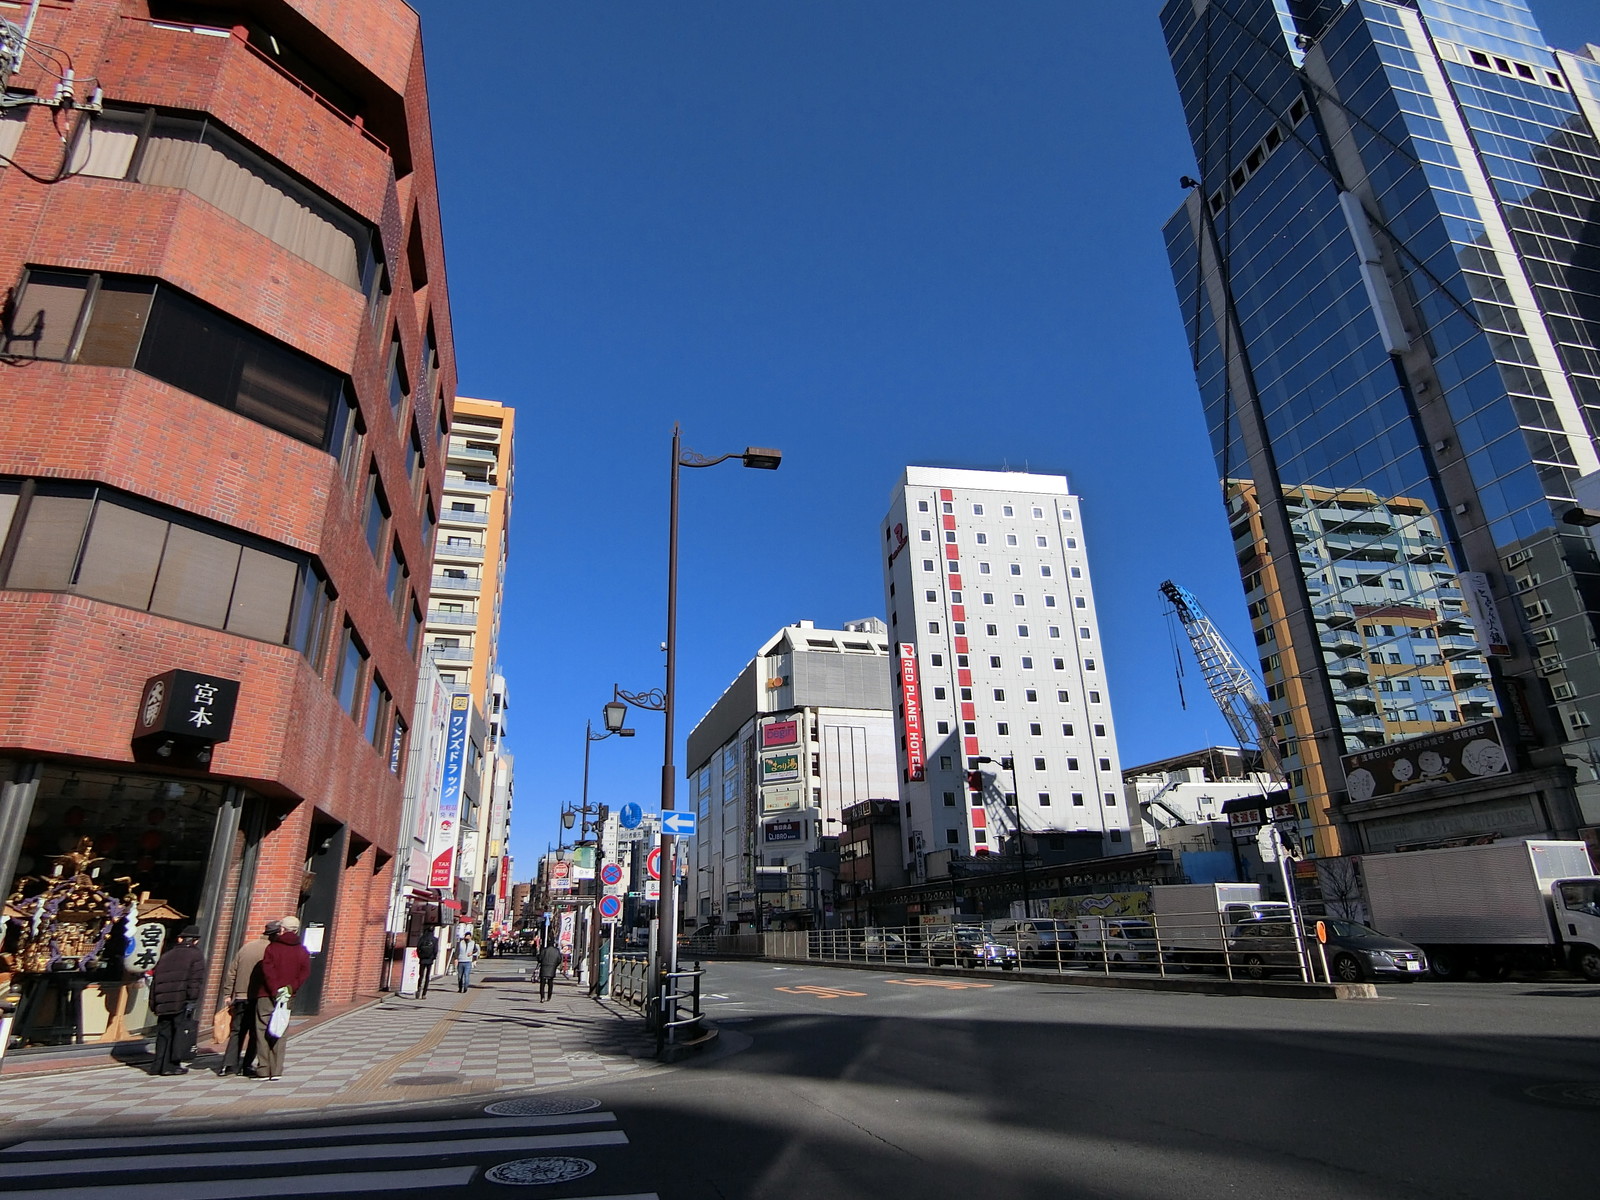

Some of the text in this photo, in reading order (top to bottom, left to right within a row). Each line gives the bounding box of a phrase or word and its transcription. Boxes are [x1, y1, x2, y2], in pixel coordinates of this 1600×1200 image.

[188, 683, 219, 728] 宮本
[904, 659, 922, 778] RED PLANET HOTELS
[767, 728, 794, 739] begin
[445, 716, 464, 798] ワンズドラッグ
[133, 925, 162, 969] 宮本
